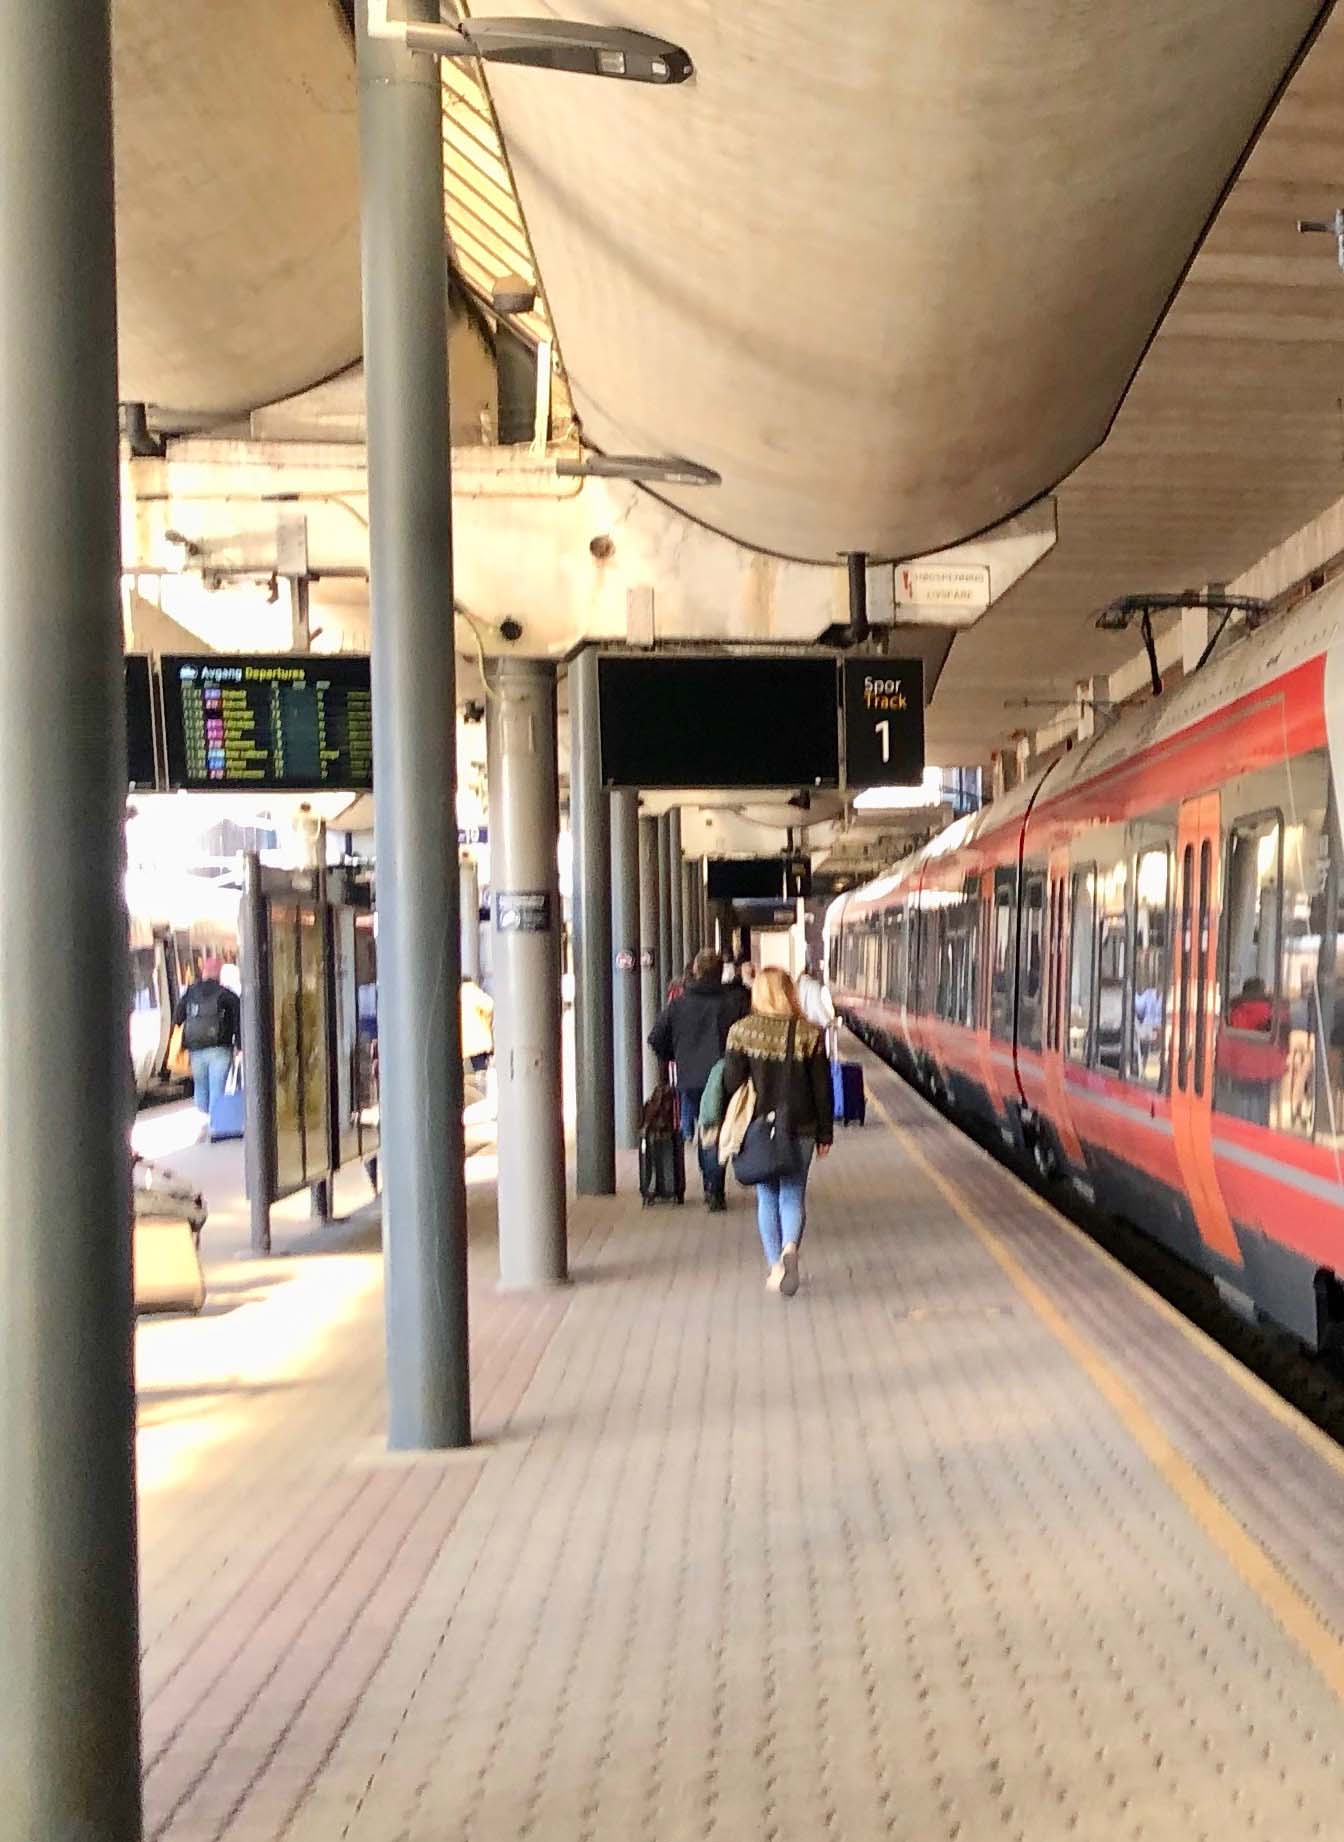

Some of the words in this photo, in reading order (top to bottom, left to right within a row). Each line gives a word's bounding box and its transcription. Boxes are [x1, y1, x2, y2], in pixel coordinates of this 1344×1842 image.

[201, 665, 242, 683] Avgang
[245, 665, 305, 682] Departures
[864, 675, 901, 695] Spor
[863, 690, 907, 710] Track
[875, 720, 889, 763] 1
